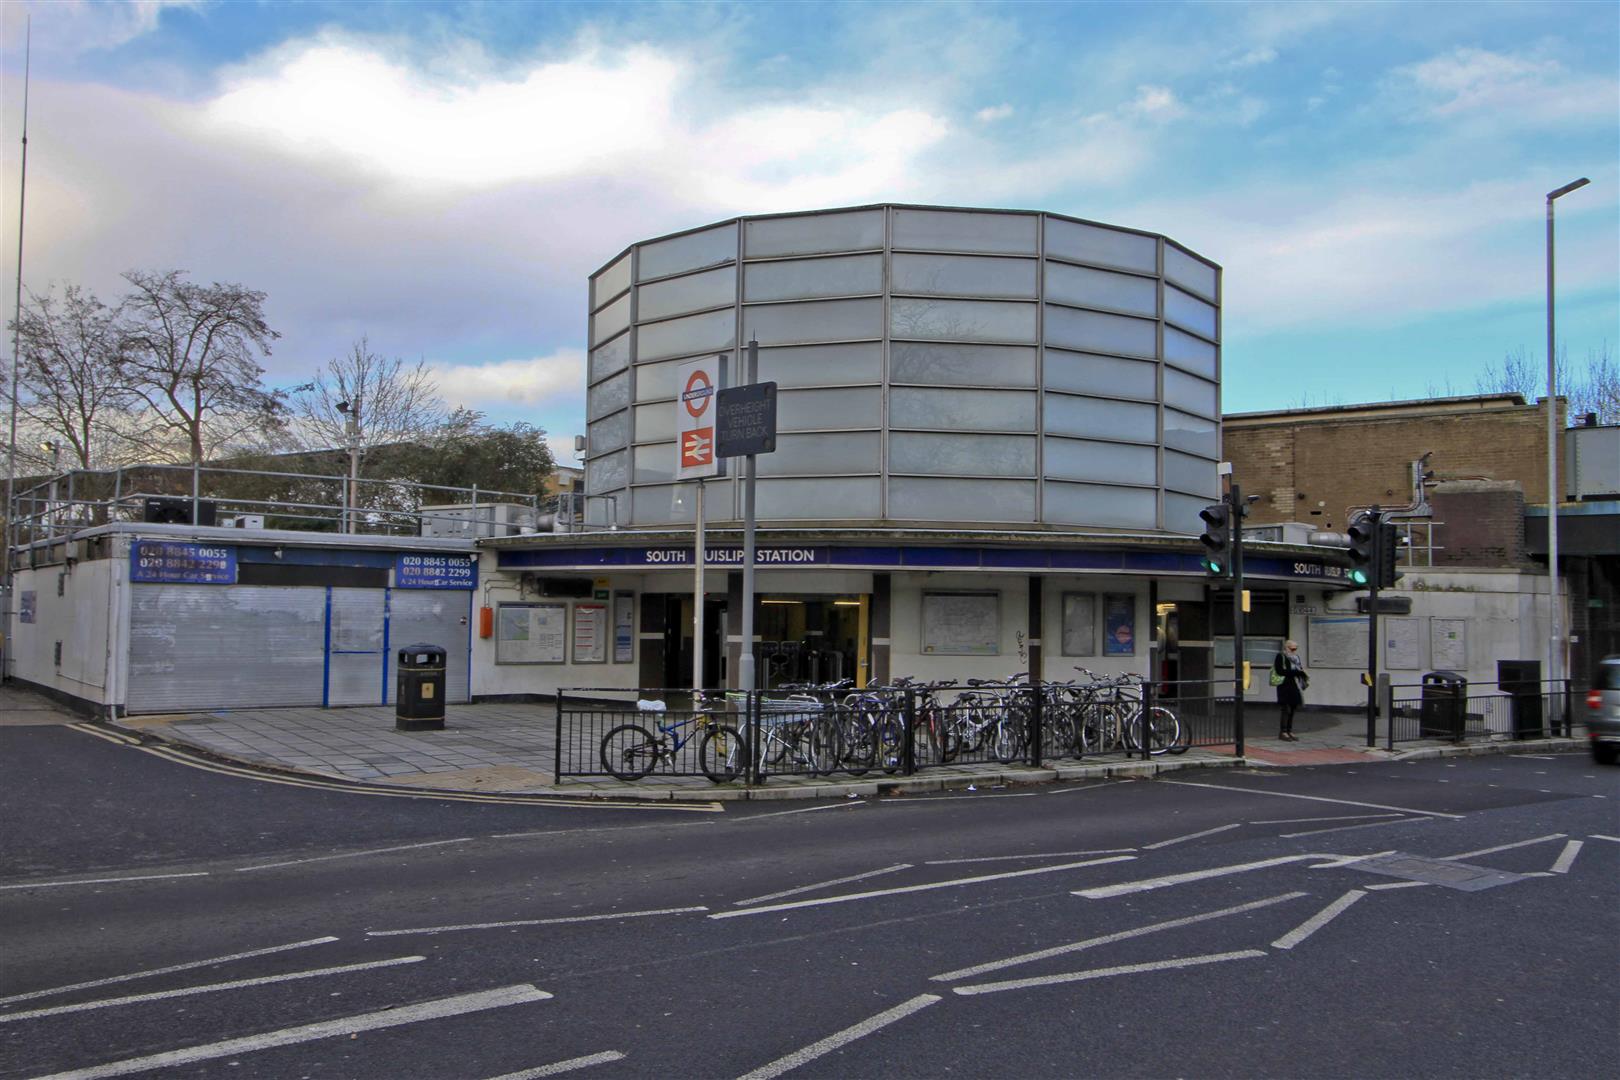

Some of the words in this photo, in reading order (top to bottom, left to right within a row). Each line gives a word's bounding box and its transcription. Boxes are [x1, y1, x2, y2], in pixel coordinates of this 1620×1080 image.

[719, 399, 771, 417] OVERHEIGHT
[728, 413, 764, 428] VEHICLE
[720, 428, 745, 441] TURN
[746, 425, 769, 439] BACK
[166, 546, 196, 557] 8845
[199, 548, 227, 558] 0055
[646, 550, 686, 563] SOUTH
[704, 549, 744, 562] UISLIP
[757, 549, 815, 562] STATION
[140, 558, 163, 568] 020
[403, 556, 421, 566] 020
[423, 557, 446, 567] 8845
[448, 558, 470, 567] 0055
[403, 567, 421, 576] 020
[448, 568, 471, 578] 2299
[1294, 563, 1321, 575] SOUTH
[449, 579, 473, 587] Service
